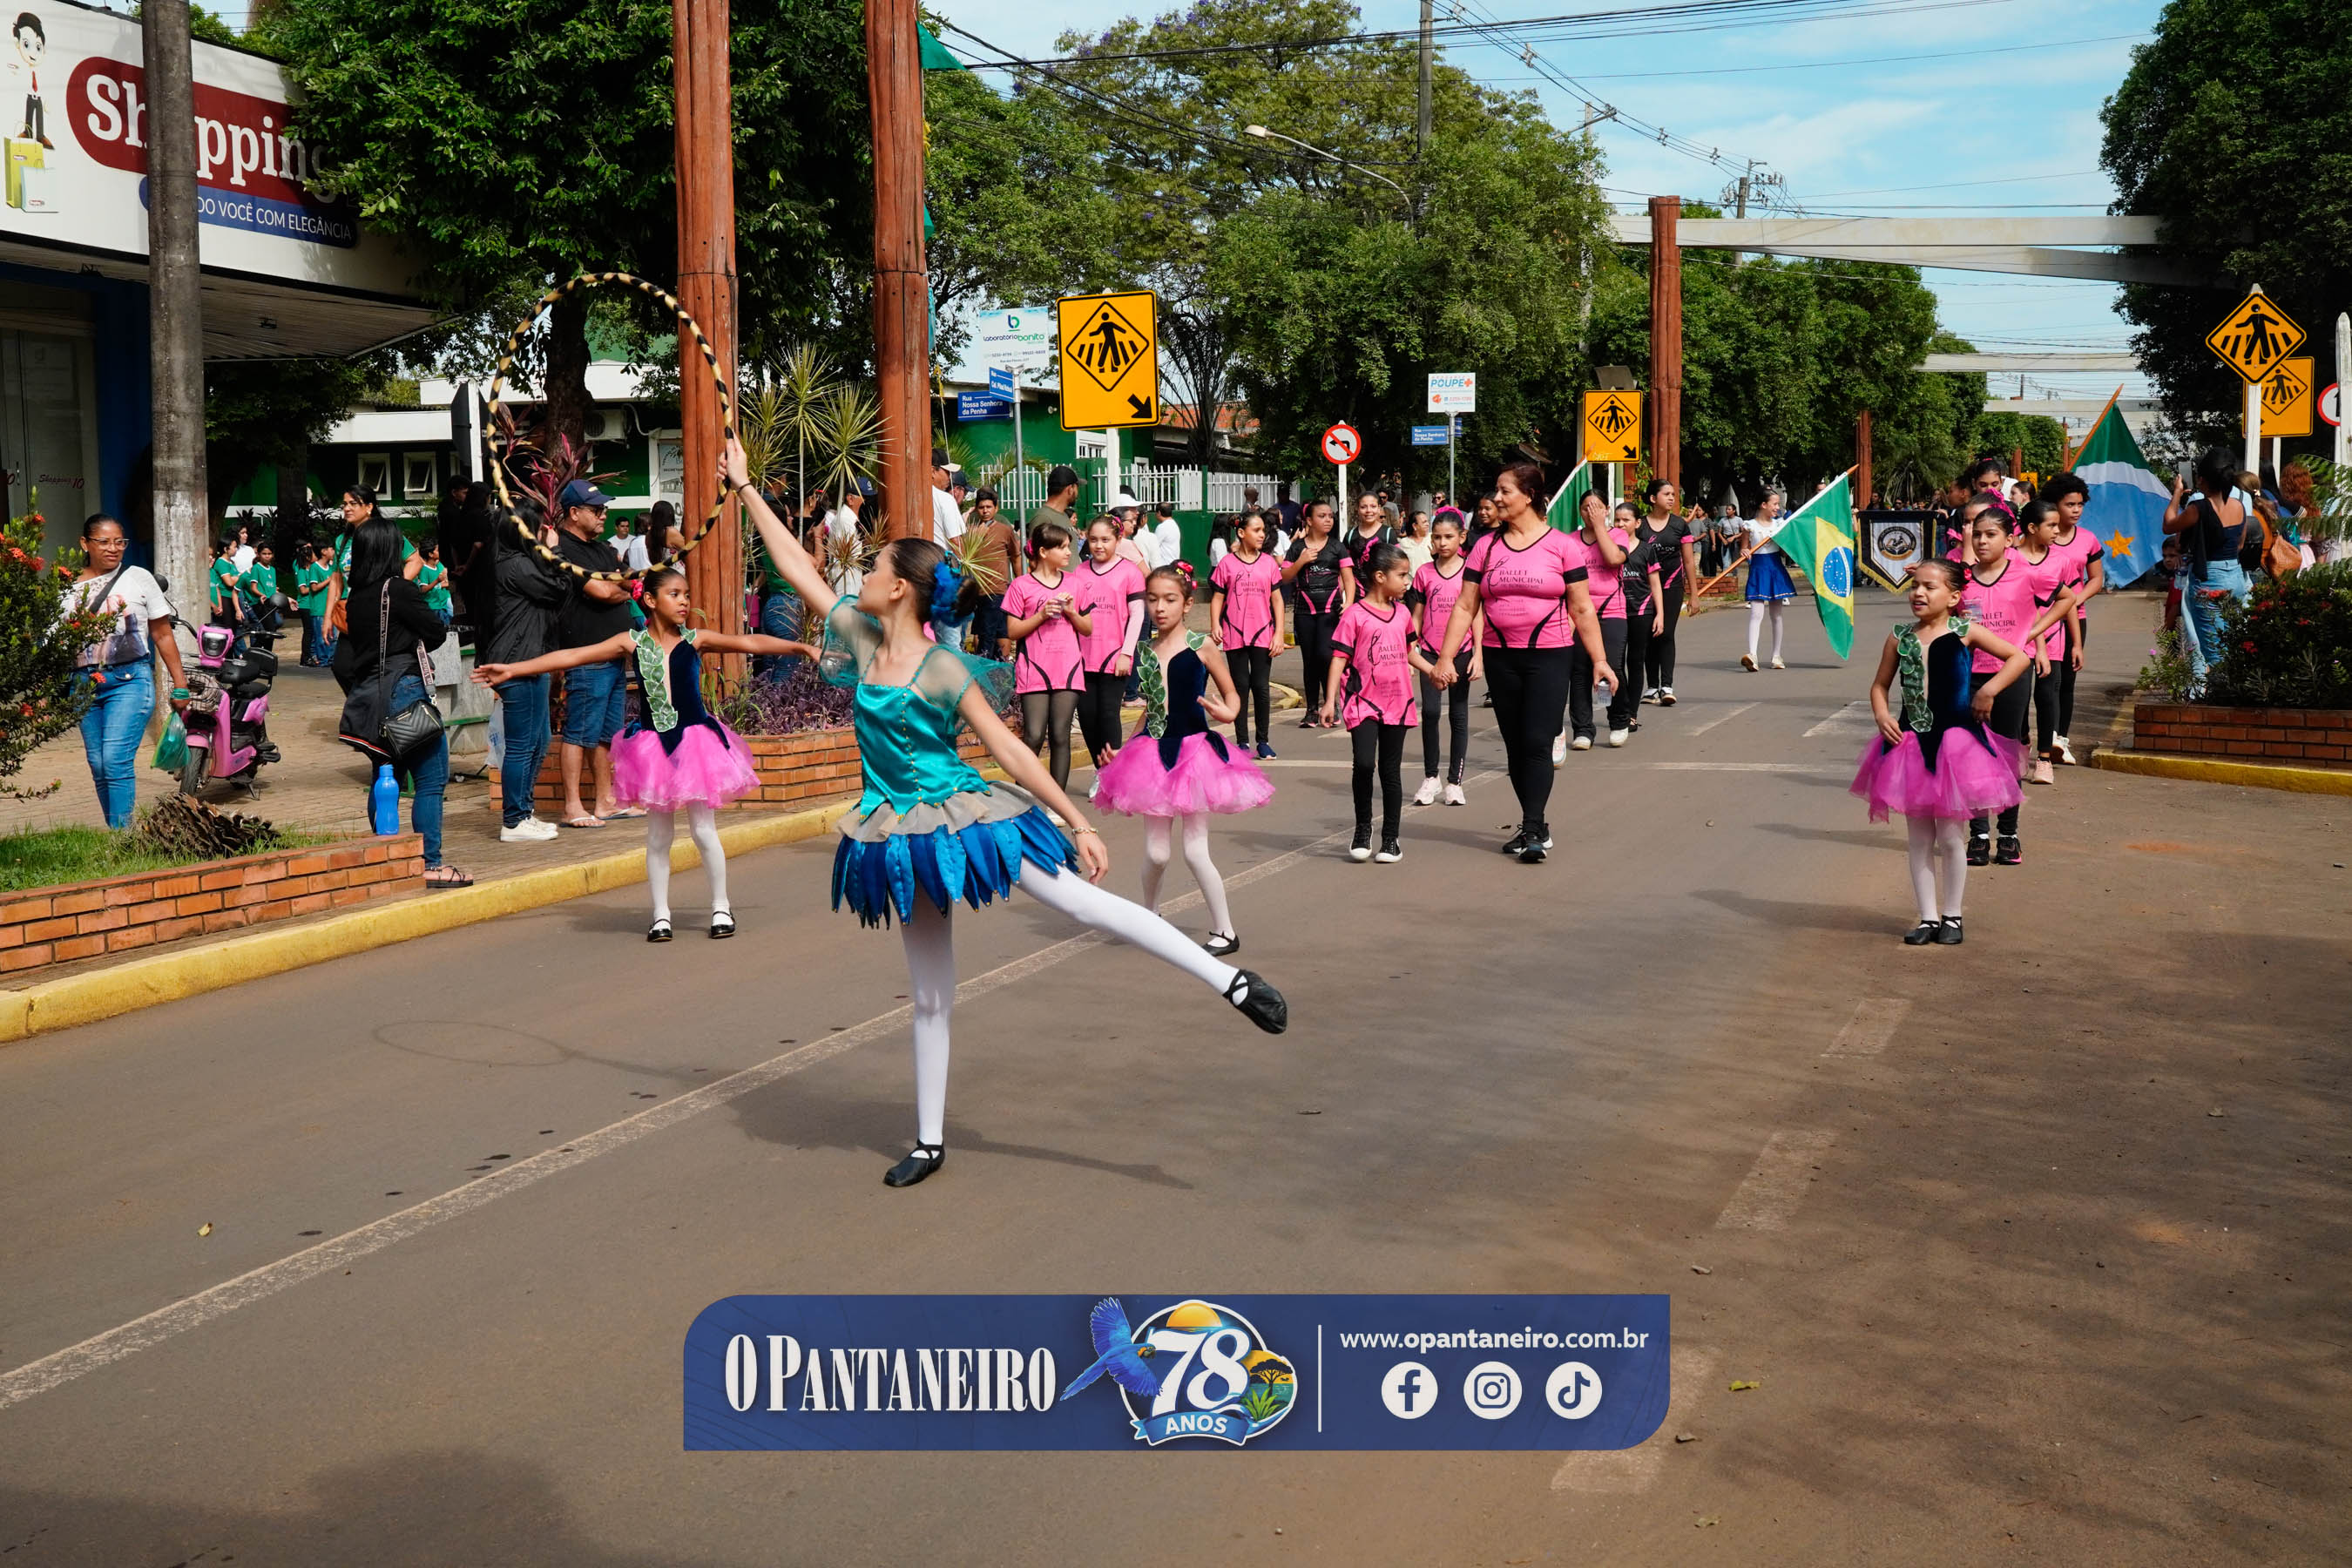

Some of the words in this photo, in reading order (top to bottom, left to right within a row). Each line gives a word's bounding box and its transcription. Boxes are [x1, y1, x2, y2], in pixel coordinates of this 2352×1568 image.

[86, 74, 336, 203] Shpping
[218, 200, 253, 222] VOCÊ
[256, 208, 286, 228] COM
[288, 213, 351, 240] ELEGÂNCIA
